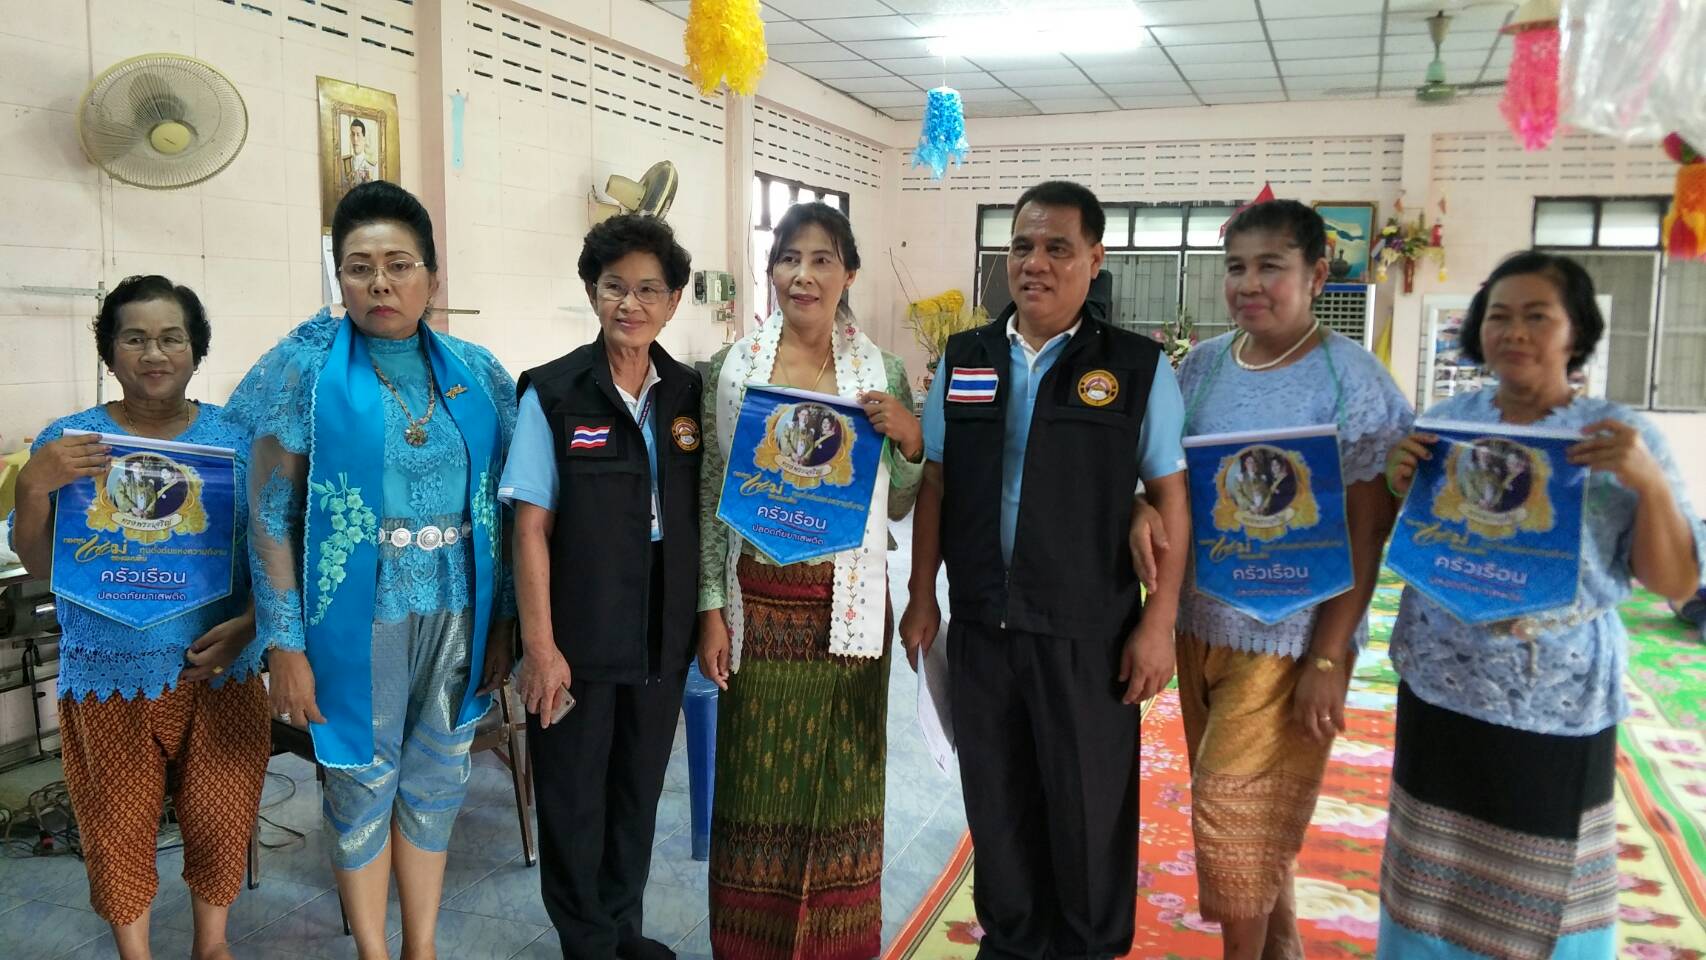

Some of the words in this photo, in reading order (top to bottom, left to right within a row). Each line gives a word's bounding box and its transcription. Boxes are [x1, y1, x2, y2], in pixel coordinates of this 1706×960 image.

[757, 505, 827, 530] ครัวเรือน
[101, 567, 186, 584] ครัวเรือน
[1232, 563, 1309, 581] ครัวเรือน
[1434, 555, 1528, 585] ครัวเรือน
[97, 591, 186, 601] ปลอดภัยยาเสพติด
